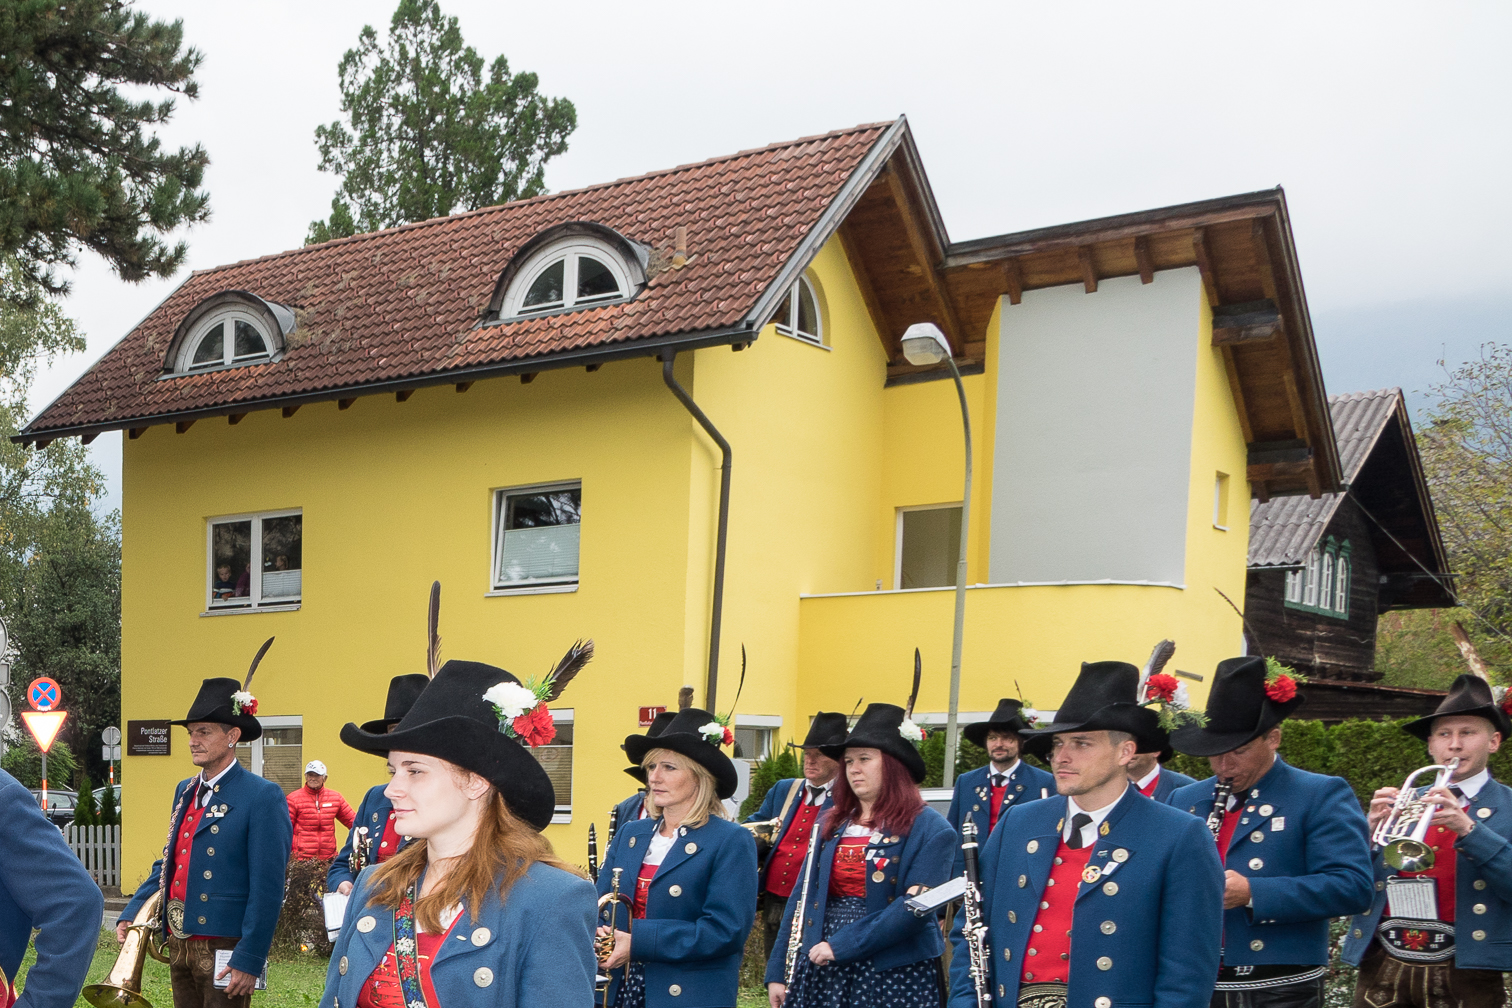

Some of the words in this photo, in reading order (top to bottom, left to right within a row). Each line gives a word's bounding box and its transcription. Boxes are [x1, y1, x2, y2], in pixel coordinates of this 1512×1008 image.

[648, 708, 657, 720] 11
[140, 727, 167, 735] Pontlatzer
[148, 735, 167, 743] Straße
